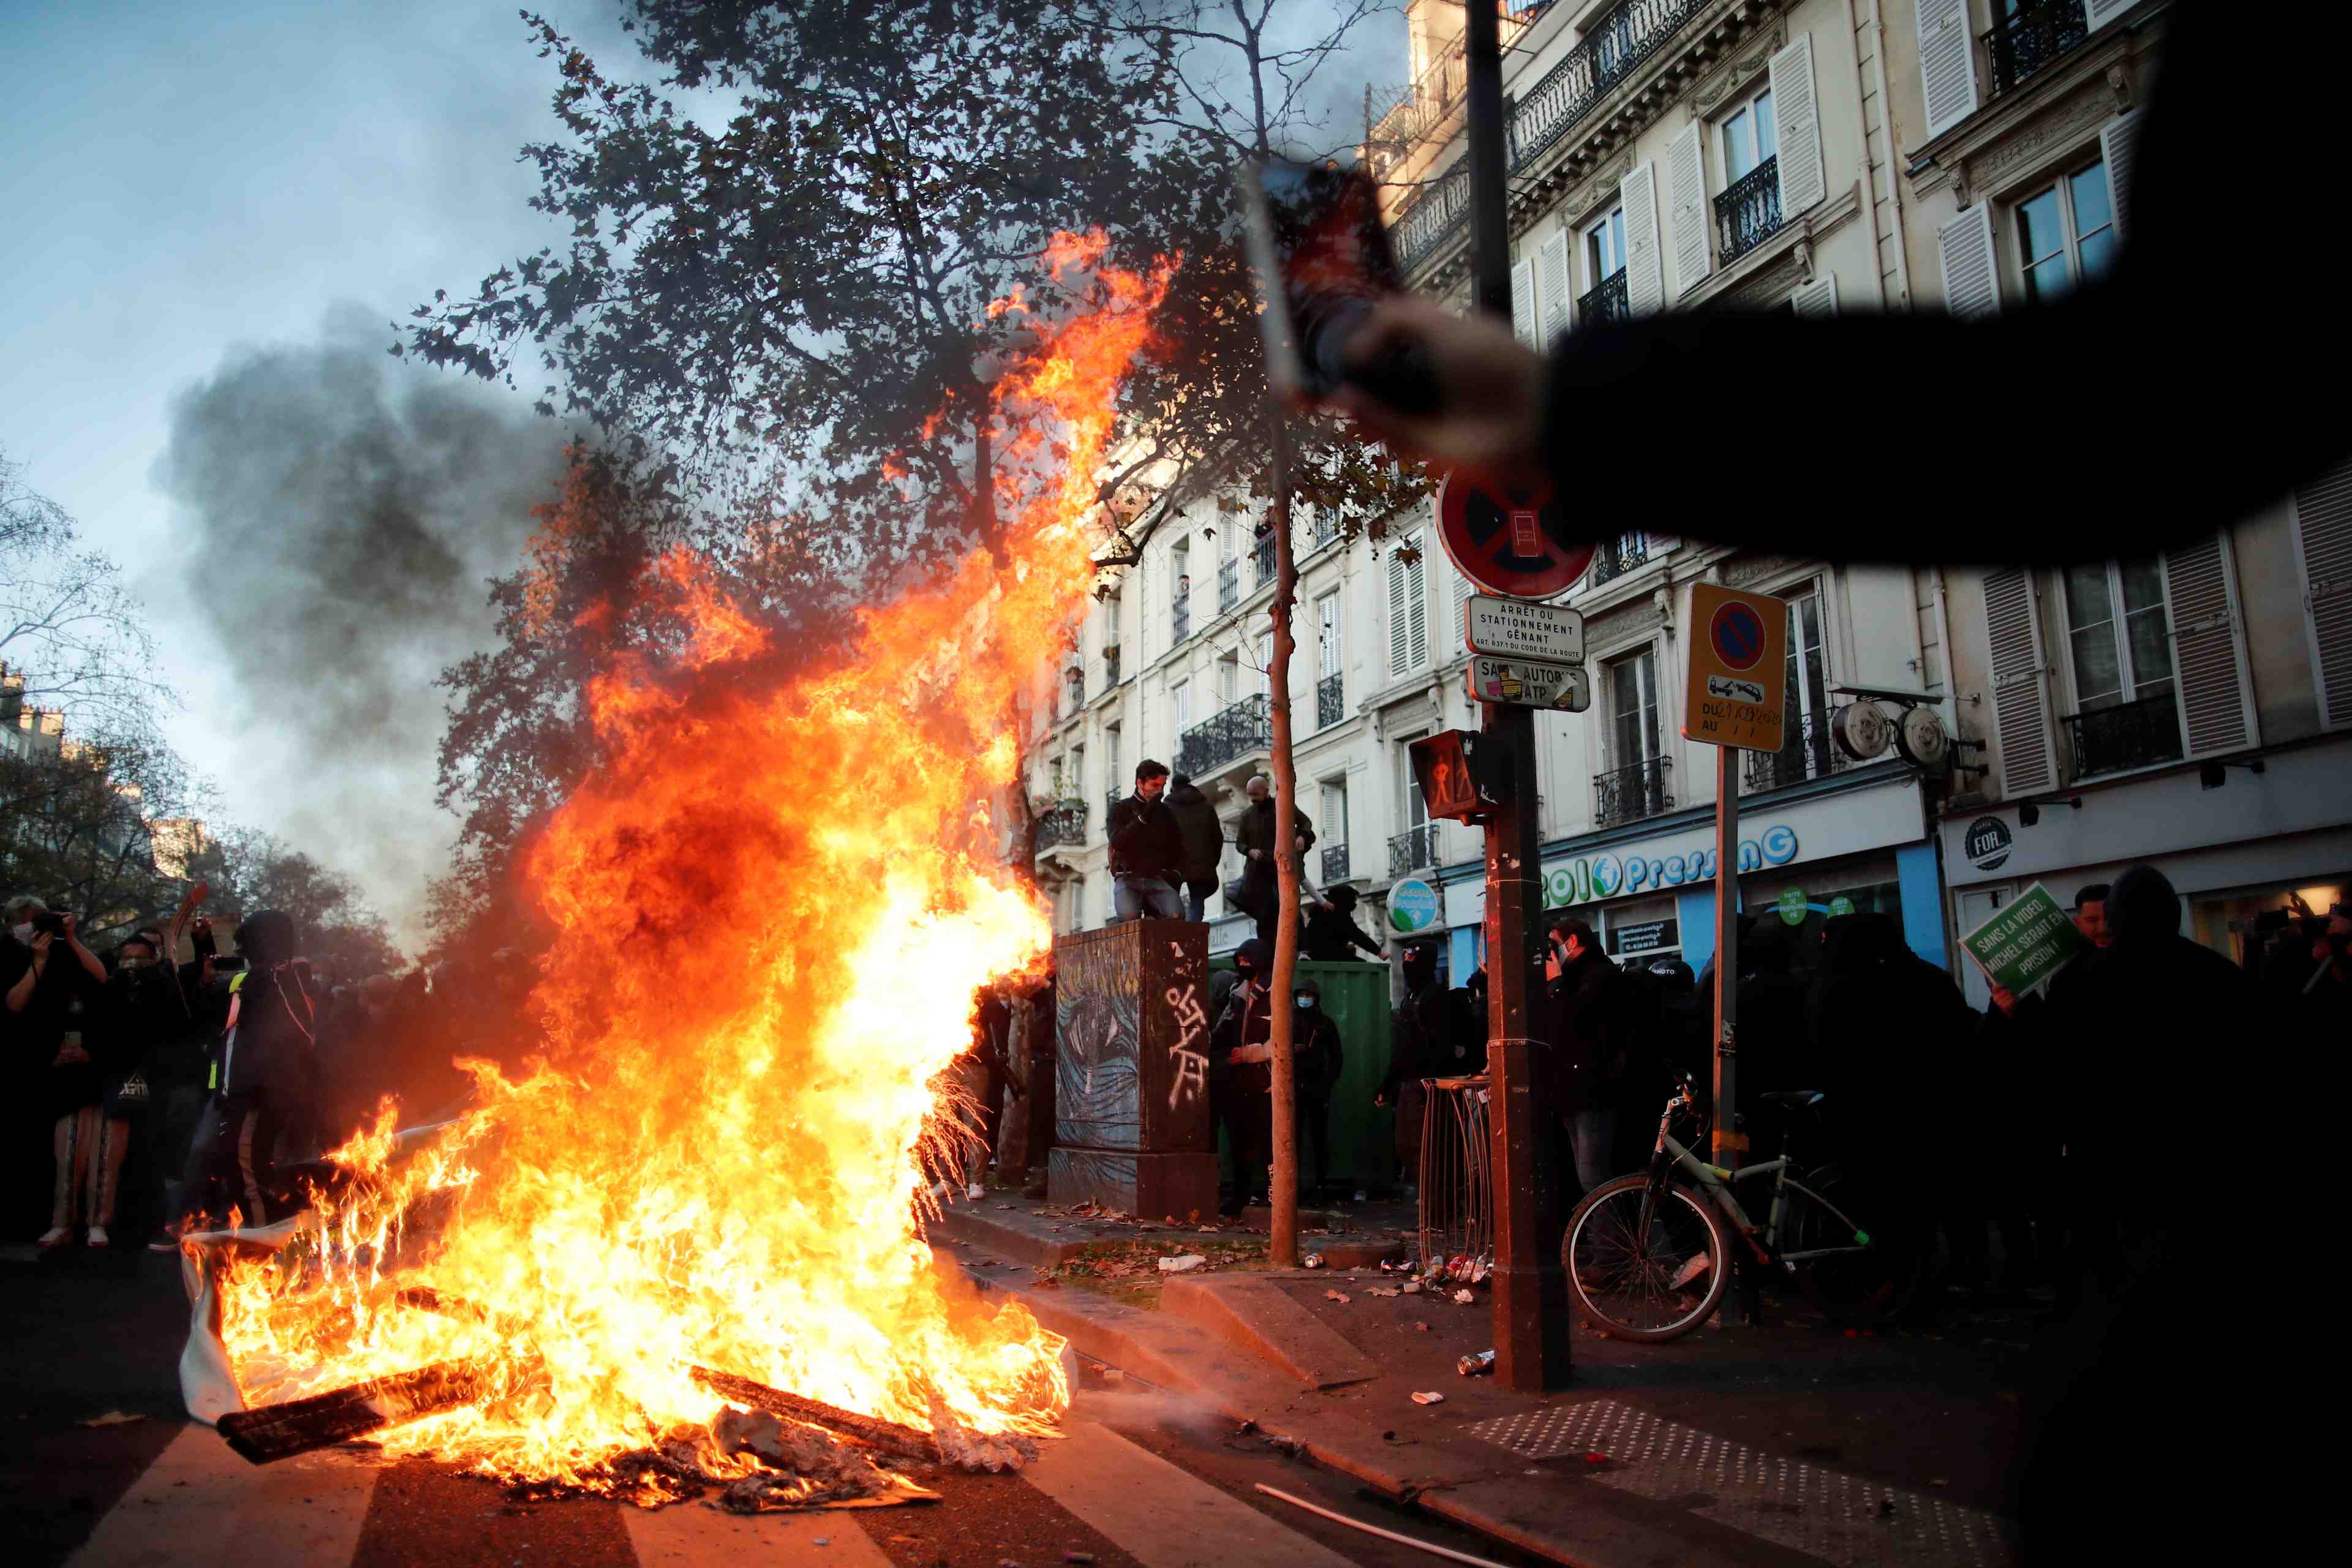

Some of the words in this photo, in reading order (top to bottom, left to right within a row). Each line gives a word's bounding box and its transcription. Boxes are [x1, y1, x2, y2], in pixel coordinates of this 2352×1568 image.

[1501, 604, 1535, 617] ARRÊT
[1540, 611, 1553, 620] OU
[1480, 614, 1573, 635] STATIONNEMENT
[1507, 630, 1549, 644] GÊNANT
[1521, 644, 1538, 652] CODE
[1559, 649, 1580, 658] ROUTE
[1521, 685, 1547, 700] ATP
[1703, 703, 1718, 716] DU
[1702, 720, 1717, 731] AU
[1977, 927, 2006, 953] SANS
[2001, 919, 2019, 935] LA
[2013, 899, 2047, 925] VIDEO,
[1985, 943, 2023, 974] MICHEL
[2018, 918, 2052, 949] SERAIT
[2048, 910, 2064, 926] EN
[2018, 946, 2057, 976] PRISON
